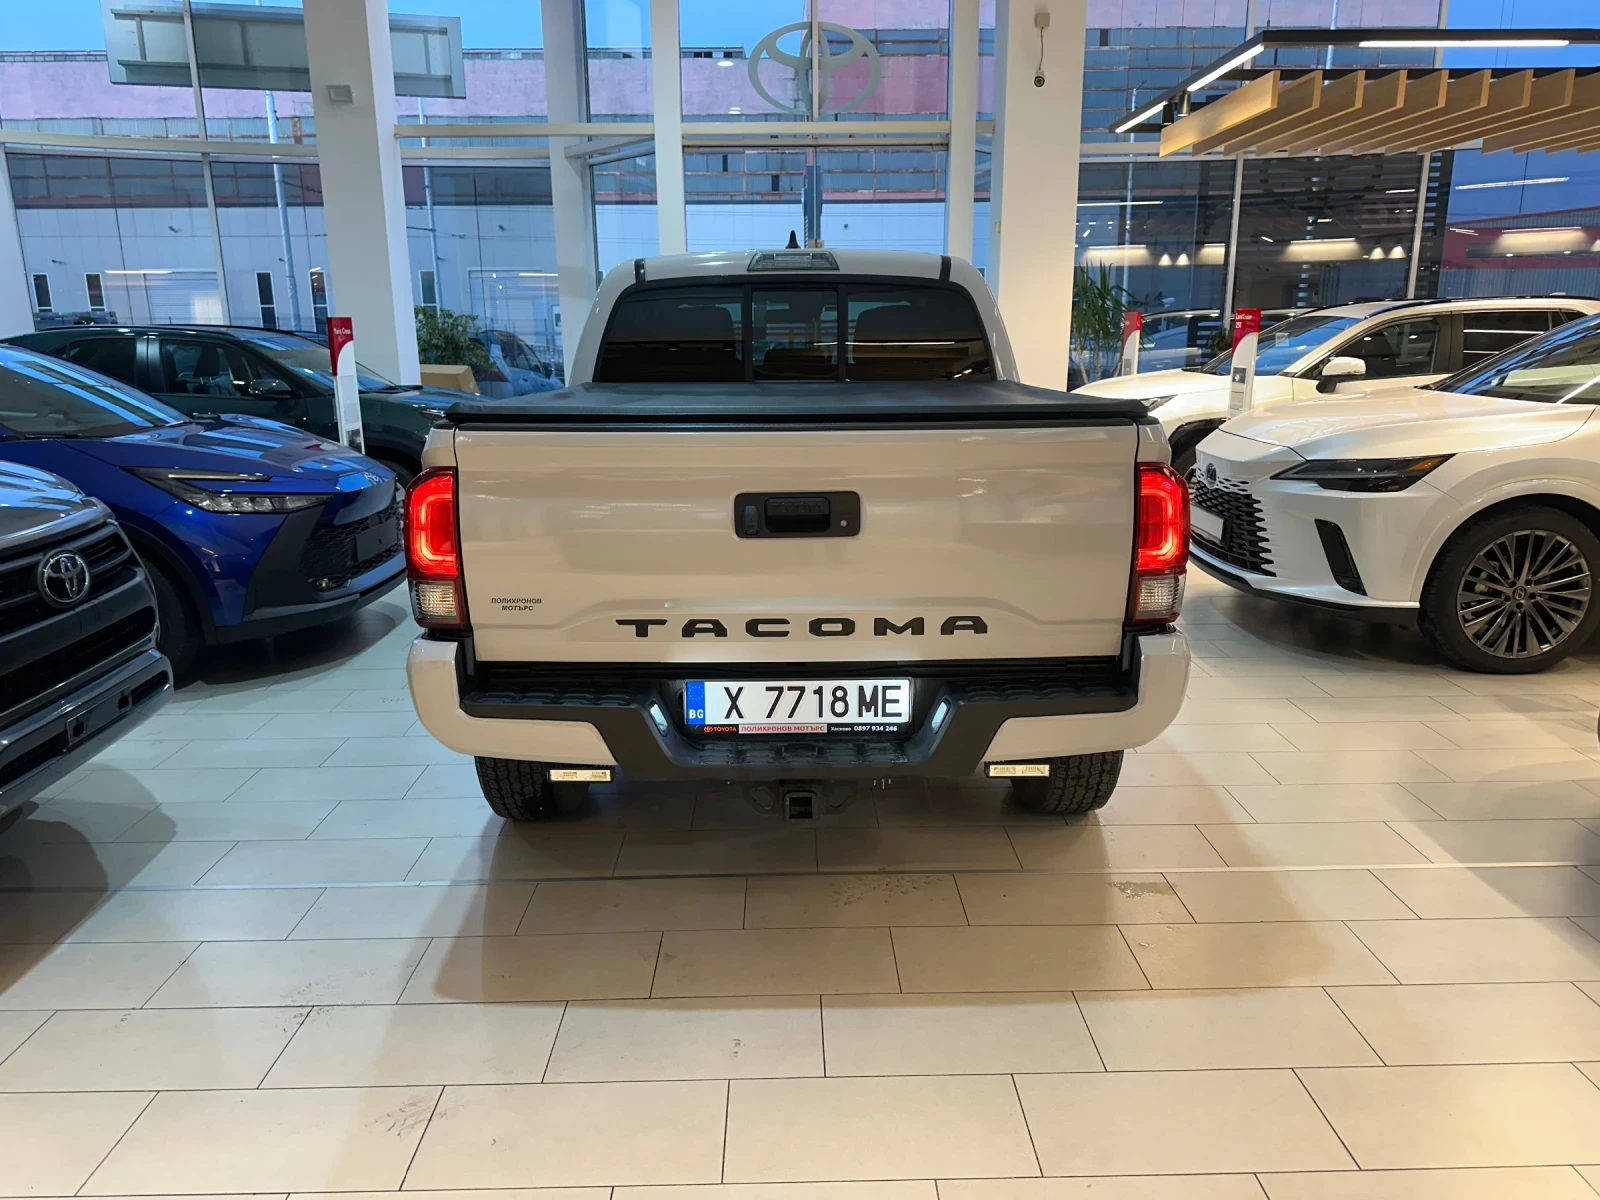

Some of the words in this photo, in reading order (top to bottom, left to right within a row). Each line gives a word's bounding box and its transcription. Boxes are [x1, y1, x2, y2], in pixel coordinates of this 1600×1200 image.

[615, 616, 988, 638] TACOMA
[724, 686, 744, 719] X
[765, 685, 850, 719] 7718
[857, 685, 902, 718] ME
[689, 709, 704, 719] BG
